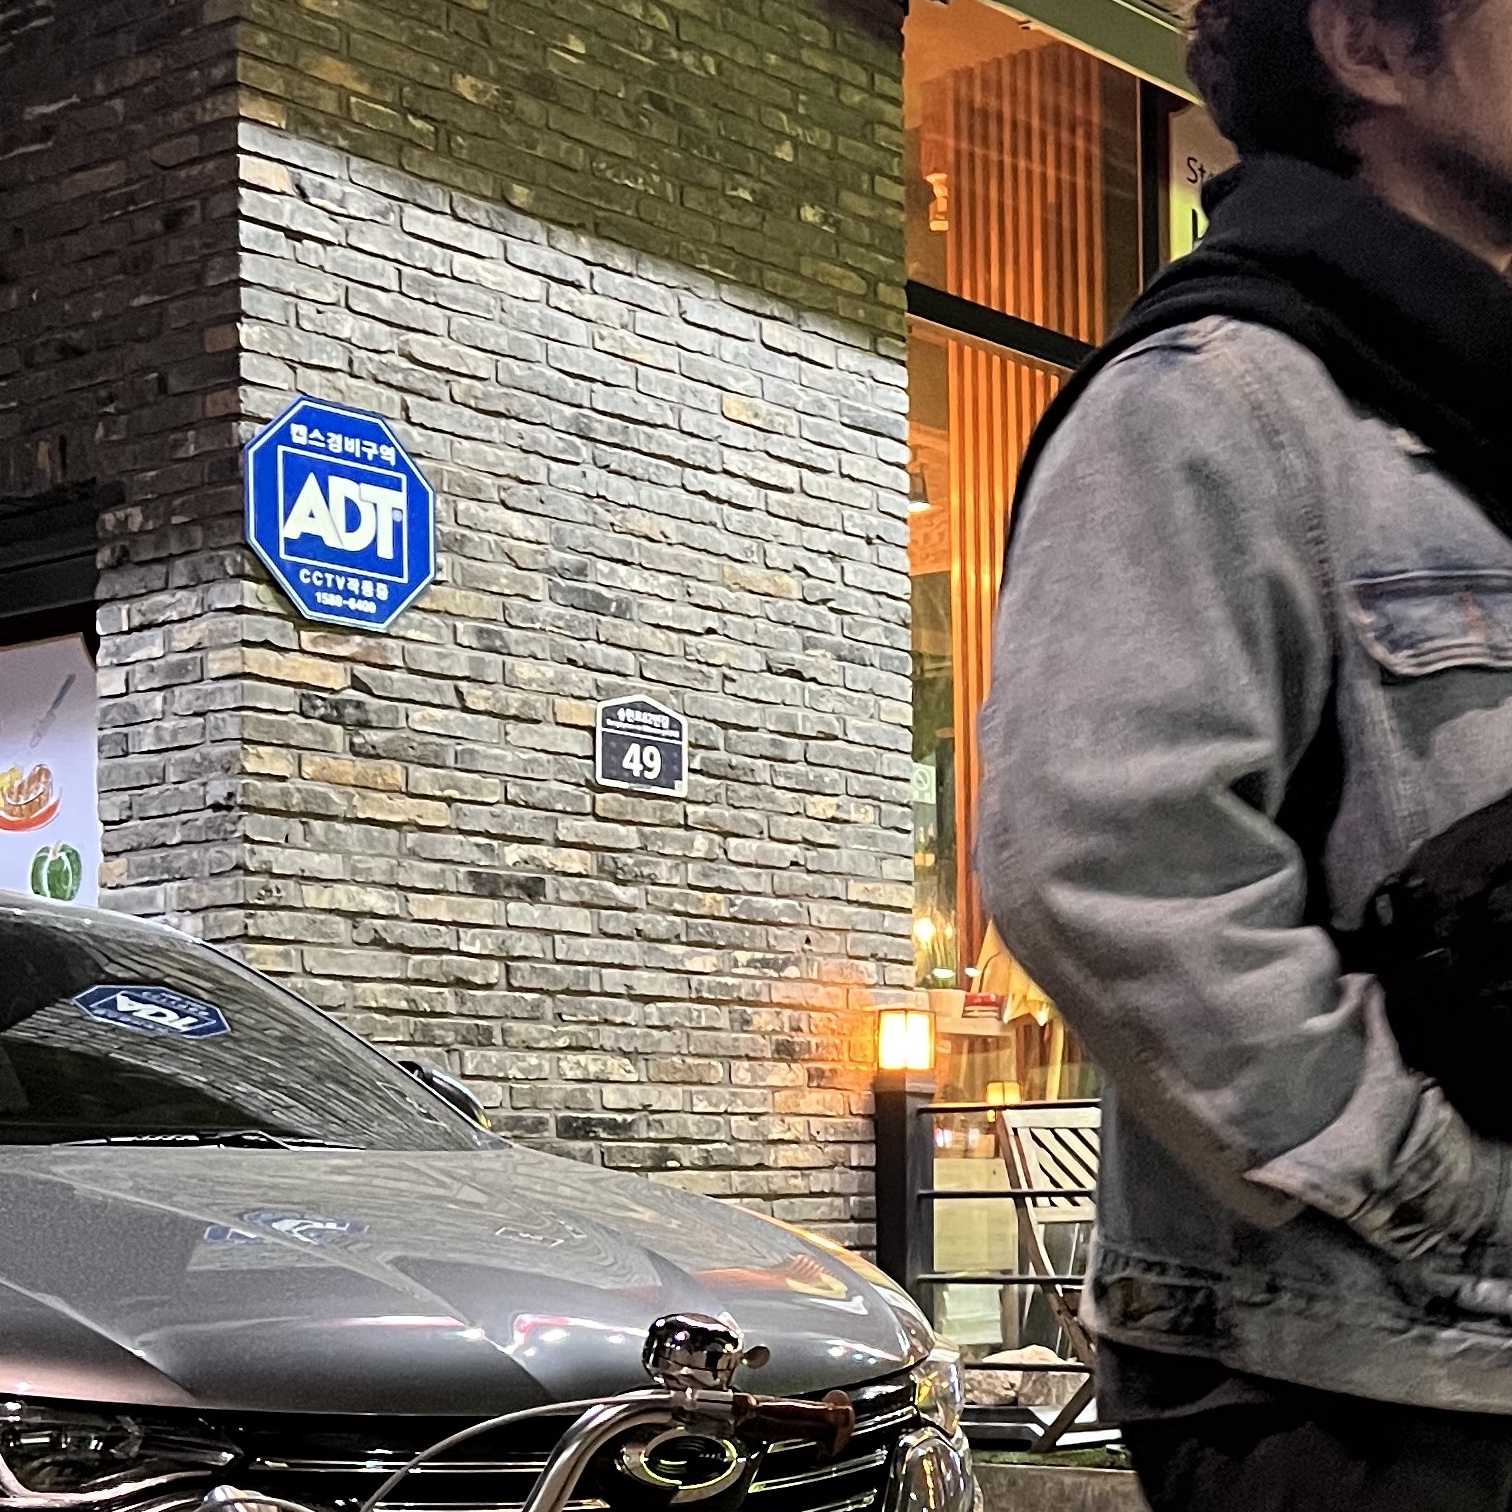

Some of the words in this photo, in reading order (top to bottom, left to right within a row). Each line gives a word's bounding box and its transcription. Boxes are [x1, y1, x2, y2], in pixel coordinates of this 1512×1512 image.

[290, 423, 396, 466] 캡스경비구역
[282, 471, 403, 560] ADT
[622, 742, 663, 780] 49
